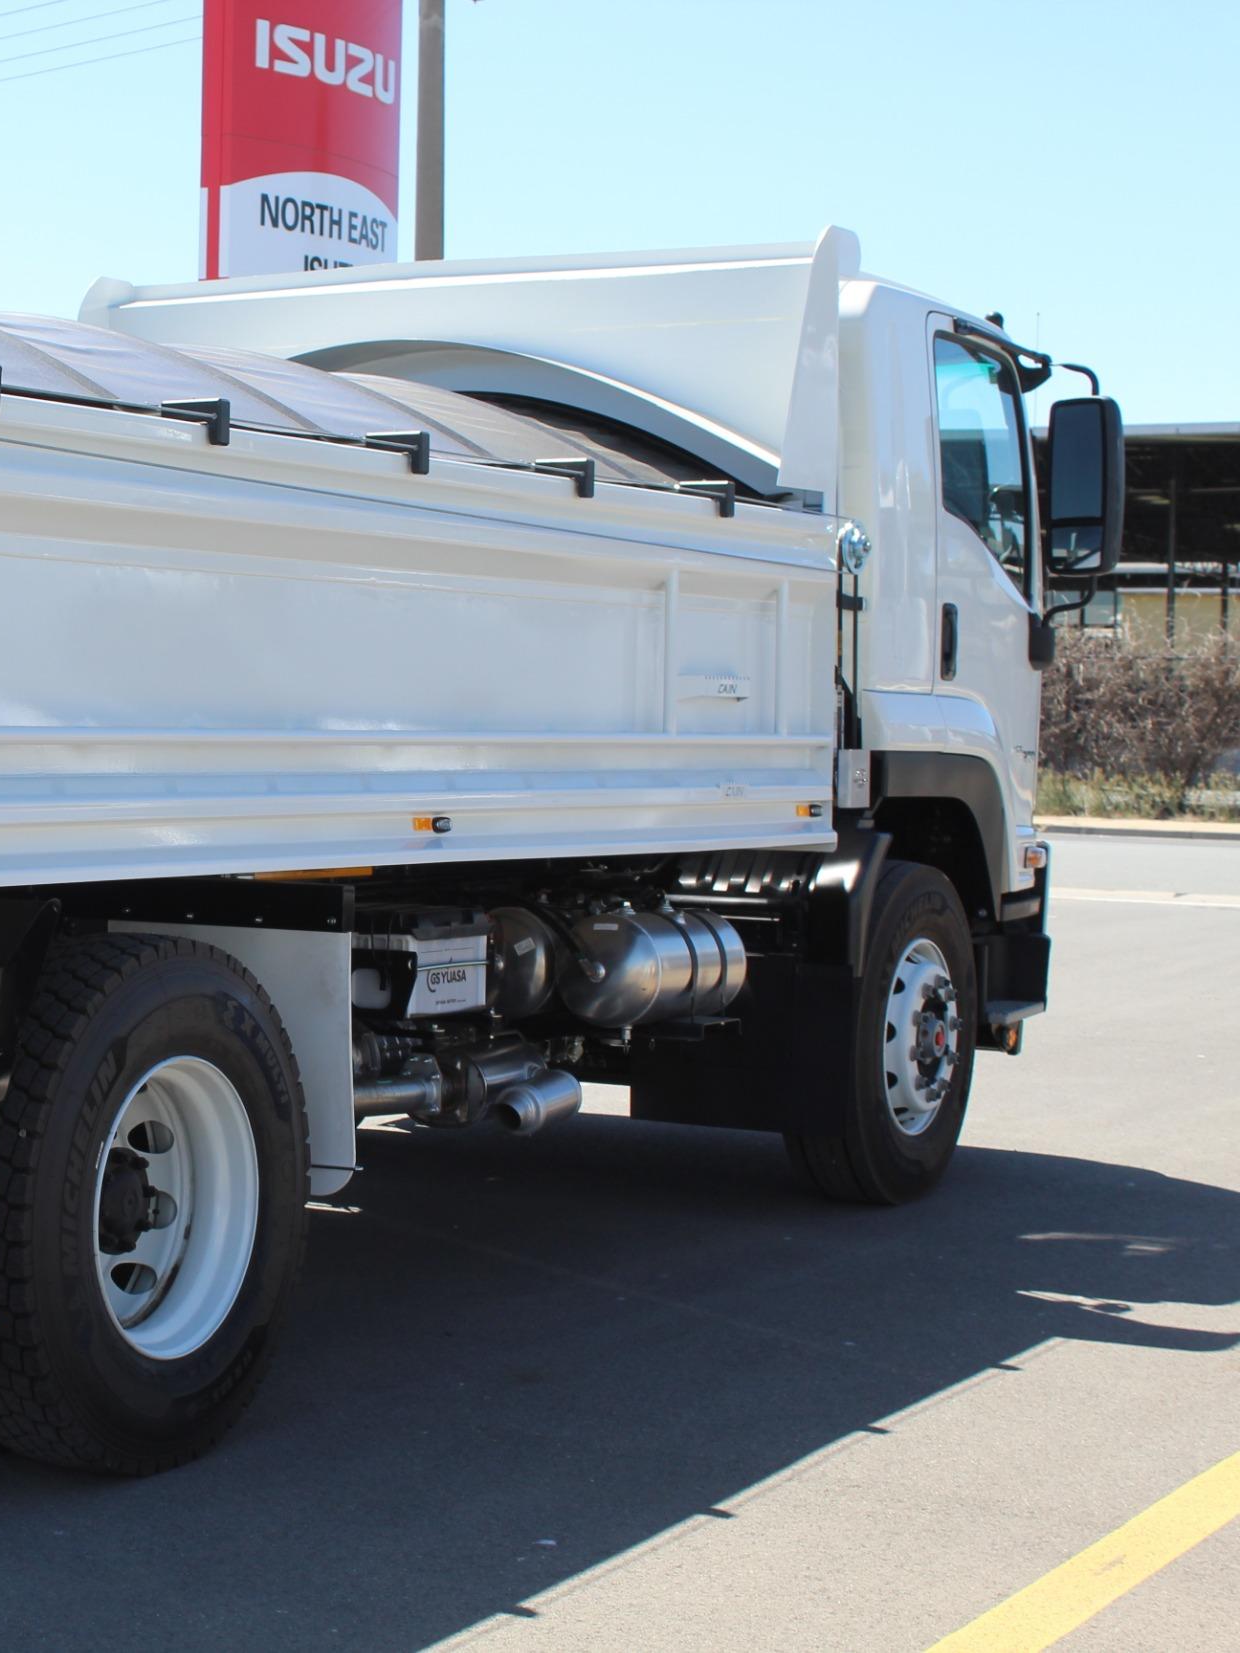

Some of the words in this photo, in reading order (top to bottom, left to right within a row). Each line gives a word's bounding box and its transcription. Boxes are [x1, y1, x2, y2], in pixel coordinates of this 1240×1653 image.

[255, 18, 396, 104] ISUZU
[260, 193, 342, 240] NORTH
[348, 210, 388, 252] EAST
[718, 684, 737, 694] CAIN
[441, 969, 466, 984] YUASA
[62, 1047, 119, 1276] MICHELIN
